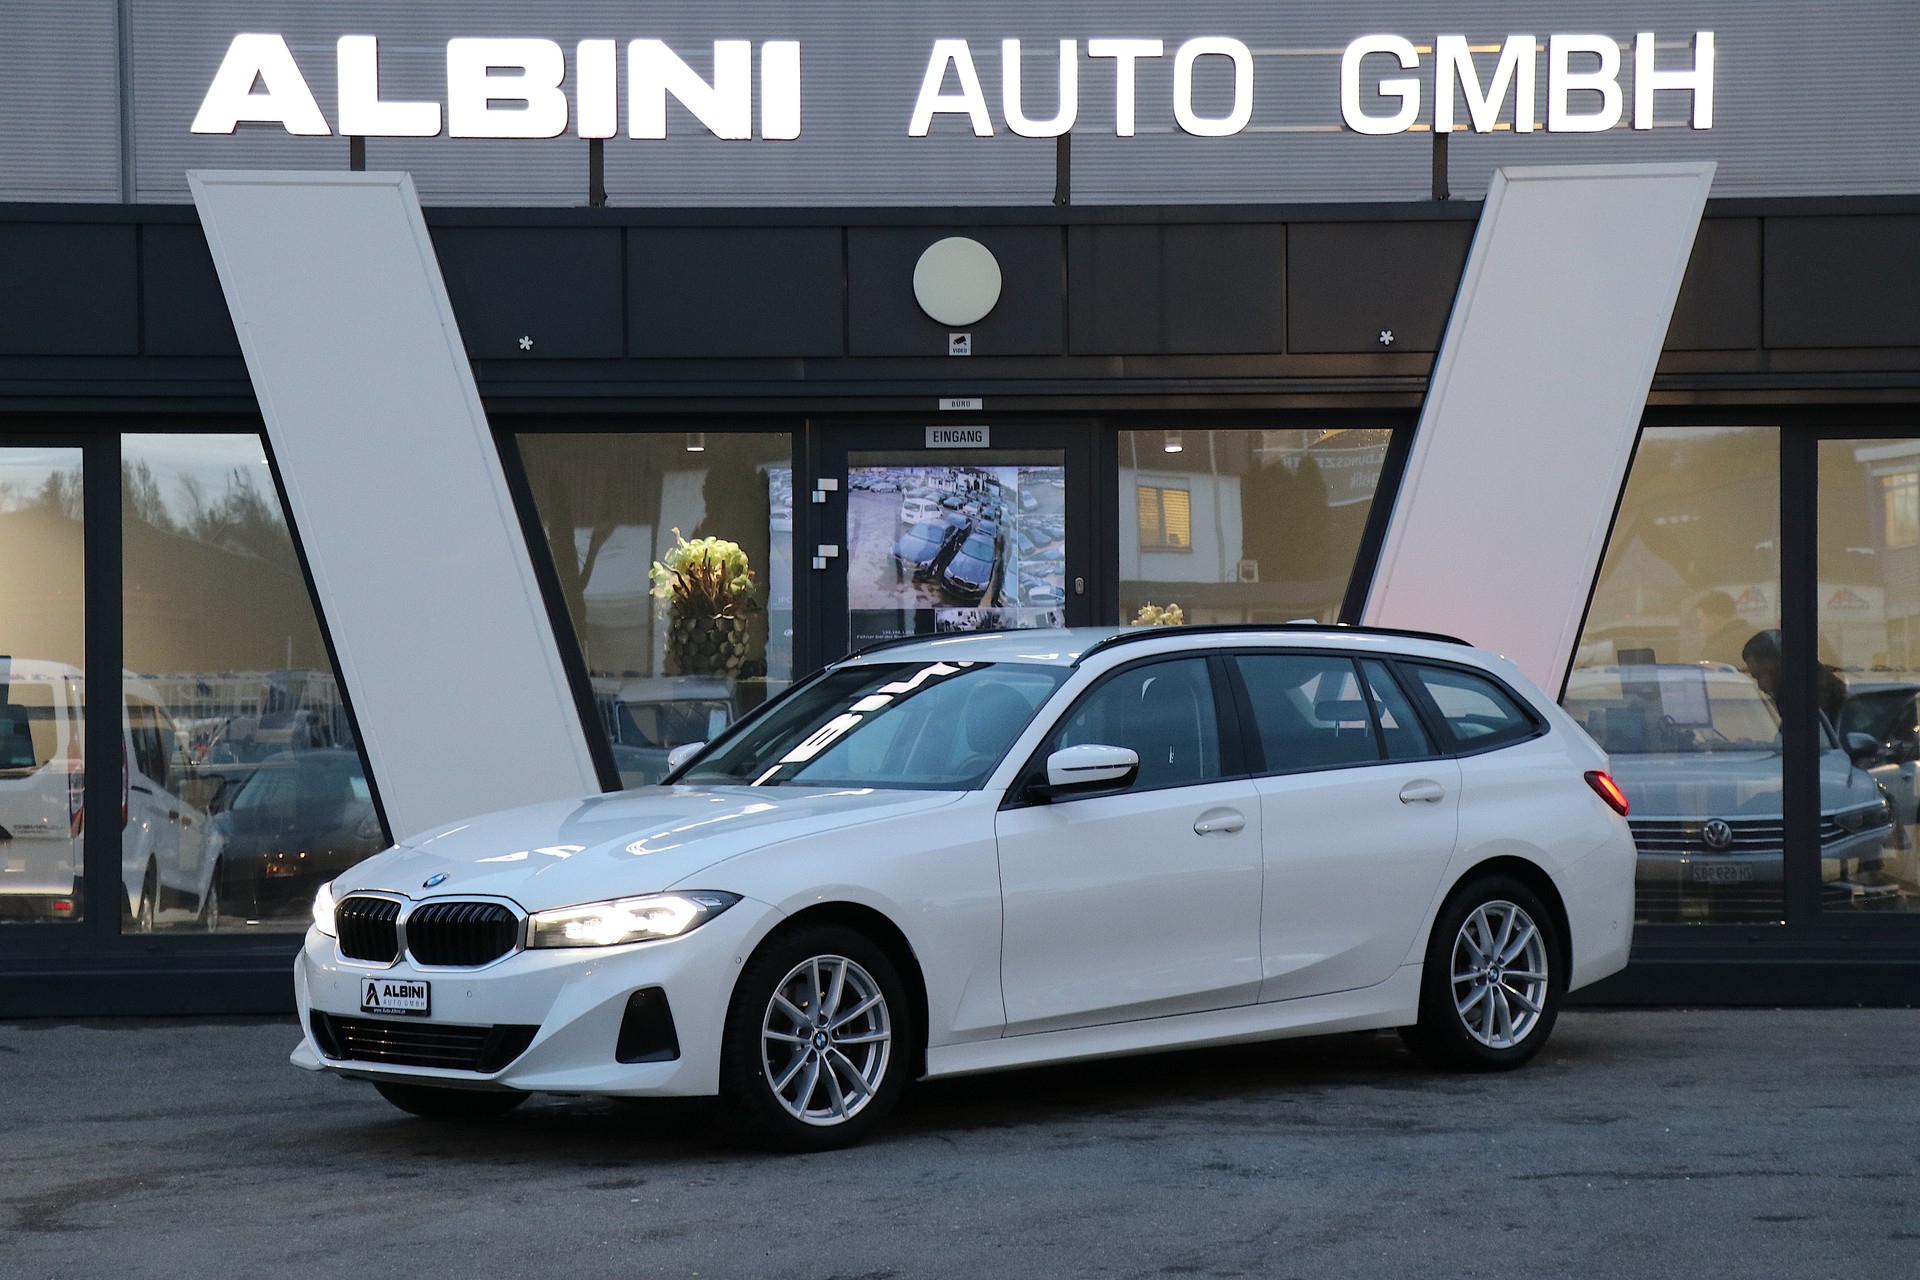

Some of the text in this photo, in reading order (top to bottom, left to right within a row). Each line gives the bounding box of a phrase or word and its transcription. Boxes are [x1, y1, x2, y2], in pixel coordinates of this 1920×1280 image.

[190, 31, 1715, 141] ALBINI AUTO GMBH
[933, 430, 982, 443] EINGANG
[383, 984, 424, 999] ALBINI
